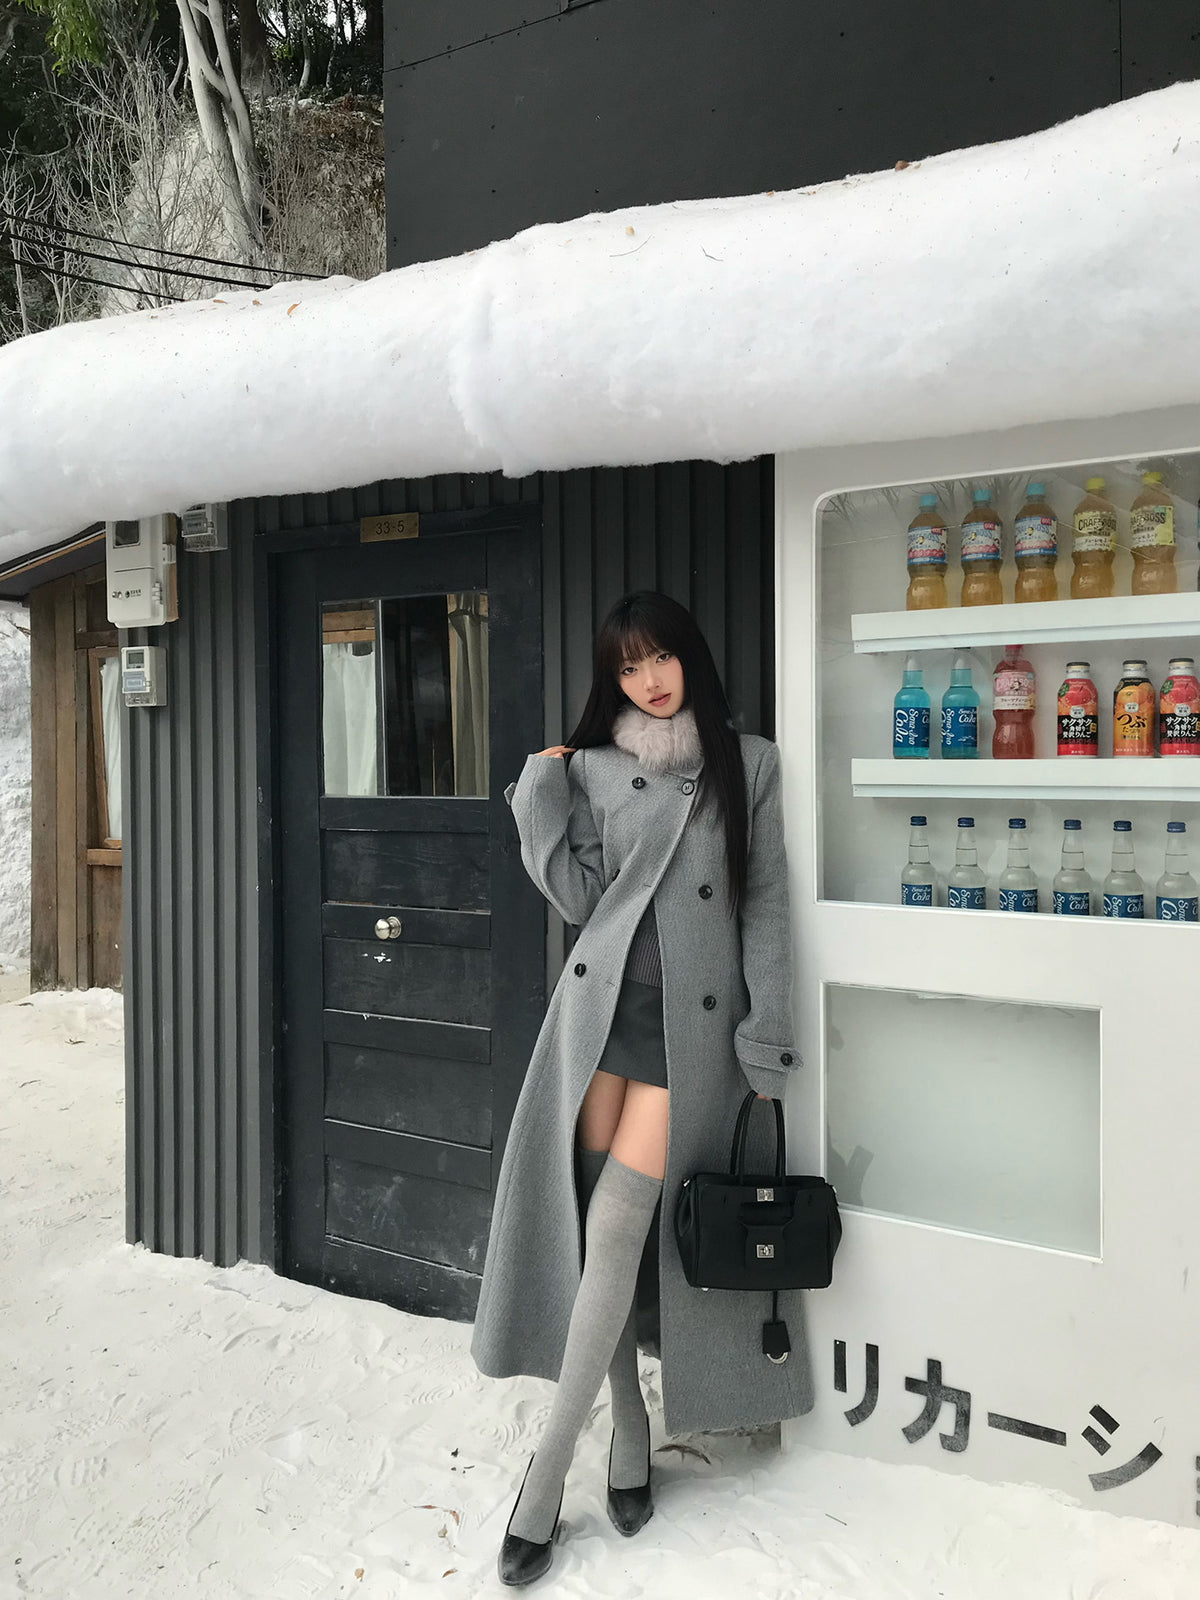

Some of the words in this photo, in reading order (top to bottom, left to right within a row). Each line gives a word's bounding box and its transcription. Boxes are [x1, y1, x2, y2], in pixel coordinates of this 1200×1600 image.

[1145, 512, 1166, 524] BOSS
[376, 520, 404, 534] 33-5
[896, 710, 908, 742] Cola
[1062, 718, 1092, 727] サクサク
[1117, 714, 1146, 728] つぶ
[1166, 717, 1198, 725] サクサク
[912, 892, 930, 901] Cola
[1069, 901, 1088, 910] Cola
[834, 1339, 1200, 1517] リカーシ
